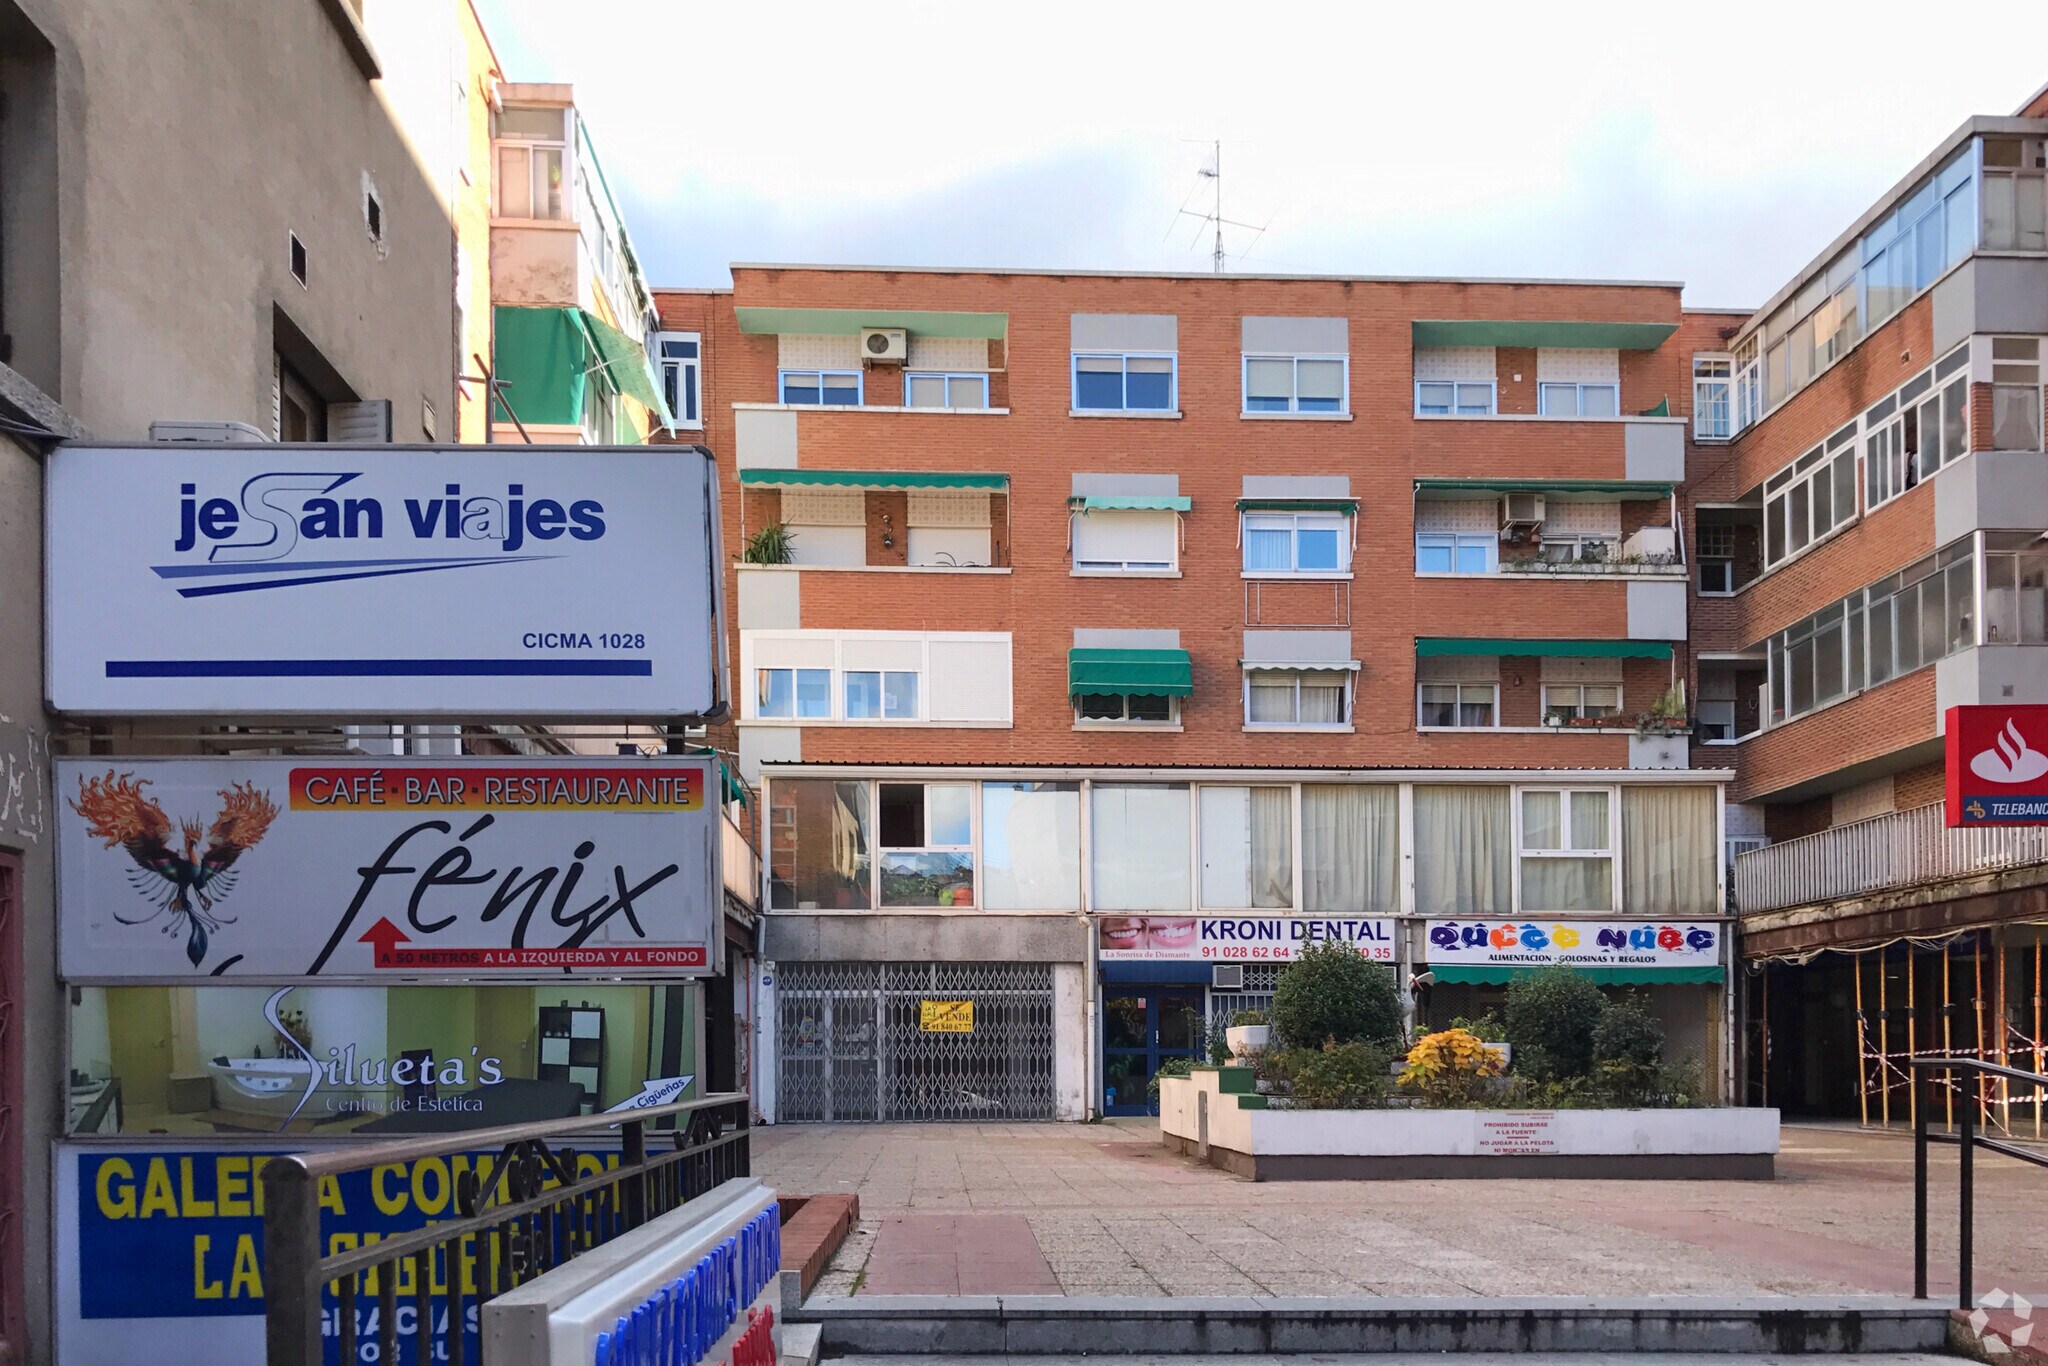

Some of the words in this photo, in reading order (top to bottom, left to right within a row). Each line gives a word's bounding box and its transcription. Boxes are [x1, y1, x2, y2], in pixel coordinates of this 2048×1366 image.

[405, 483, 605, 551] viajes
[523, 632, 593, 649] CICMA
[599, 632, 646, 649] 1028
[305, 770, 386, 805] CAFÉ
[405, 776, 465, 805] BAR
[485, 776, 690, 805] RESTAURANTE
[306, 814, 679, 974] fénix
[1201, 920, 1281, 941] KRONI
[1291, 920, 1391, 941] DENTAL
[1596, 927, 1715, 950] NUBE
[396, 954, 413, 964] 50
[419, 953, 479, 964] METROS
[484, 953, 494, 963] A
[499, 953, 517, 963] LA
[521, 952, 604, 963] IZQUIERDA
[610, 952, 619, 962] Y
[624, 952, 642, 962] AL
[647, 951, 699, 962] FONDO
[1202, 946, 1217, 958] 91
[1223, 946, 1248, 958] 028
[1252, 946, 1268, 958] 62
[1273, 946, 1289, 958] 64
[1374, 947, 1391, 959] 35
[1488, 954, 1551, 962] ALIMENTACION
[1559, 955, 1607, 963] GOLOSINAS
[940, 1012, 971, 1021] VENDE
[263, 985, 505, 1134] Silueta's
[637, 1078, 685, 1106] Cigüeñas
[390, 1096, 410, 1112] de
[418, 1095, 484, 1112] Estética
